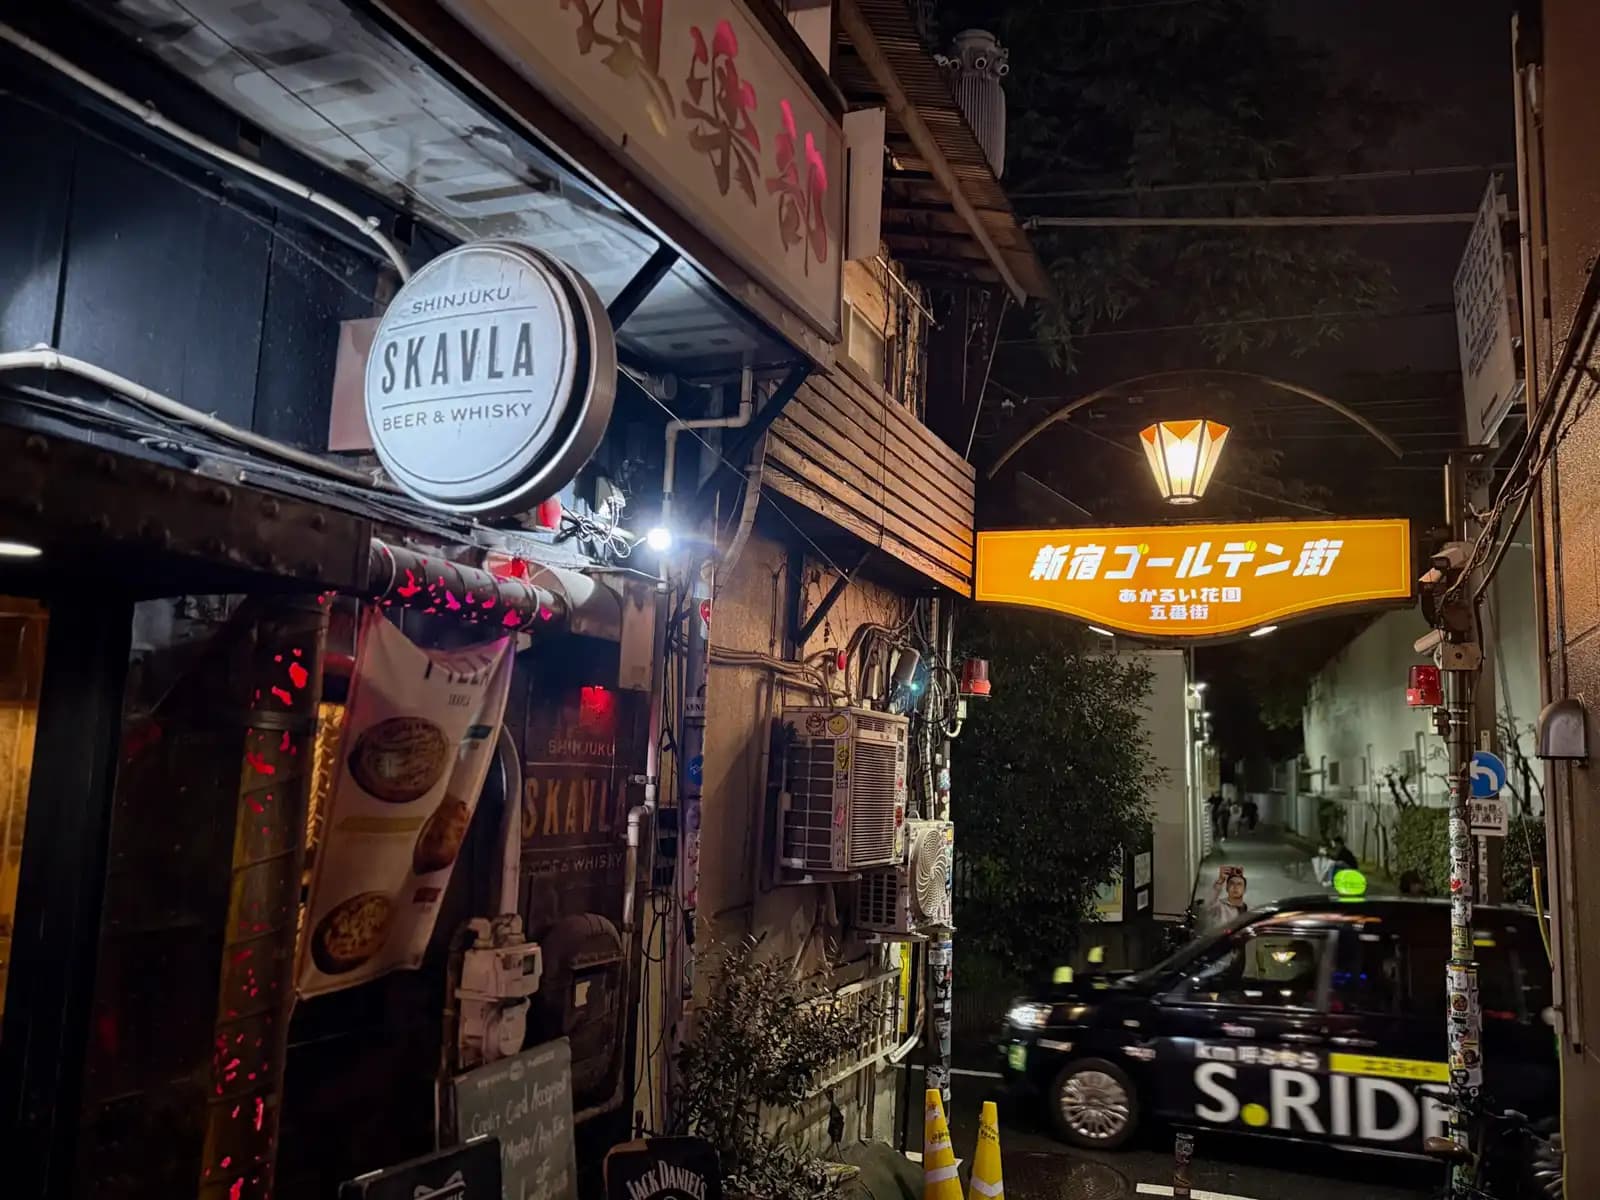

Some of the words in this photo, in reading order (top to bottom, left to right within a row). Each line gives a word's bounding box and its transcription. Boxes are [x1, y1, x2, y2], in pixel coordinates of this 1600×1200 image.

[411, 288, 511, 314] SHINJUKU
[382, 322, 534, 394] SKAVLA
[382, 410, 427, 432] BEER
[433, 411, 445, 424] &
[450, 402, 533, 422] WHISKY
[1029, 538, 1343, 582] 新宿ゴールデン街
[1118, 586, 1242, 603] あかるい花園
[1148, 604, 1209, 621] 五番街
[548, 738, 615, 757] SHINJUKU
[521, 776, 628, 841] SKAVLA
[625, 1168, 661, 1200] JACK
[657, 1160, 708, 1200] DANIEL'S
